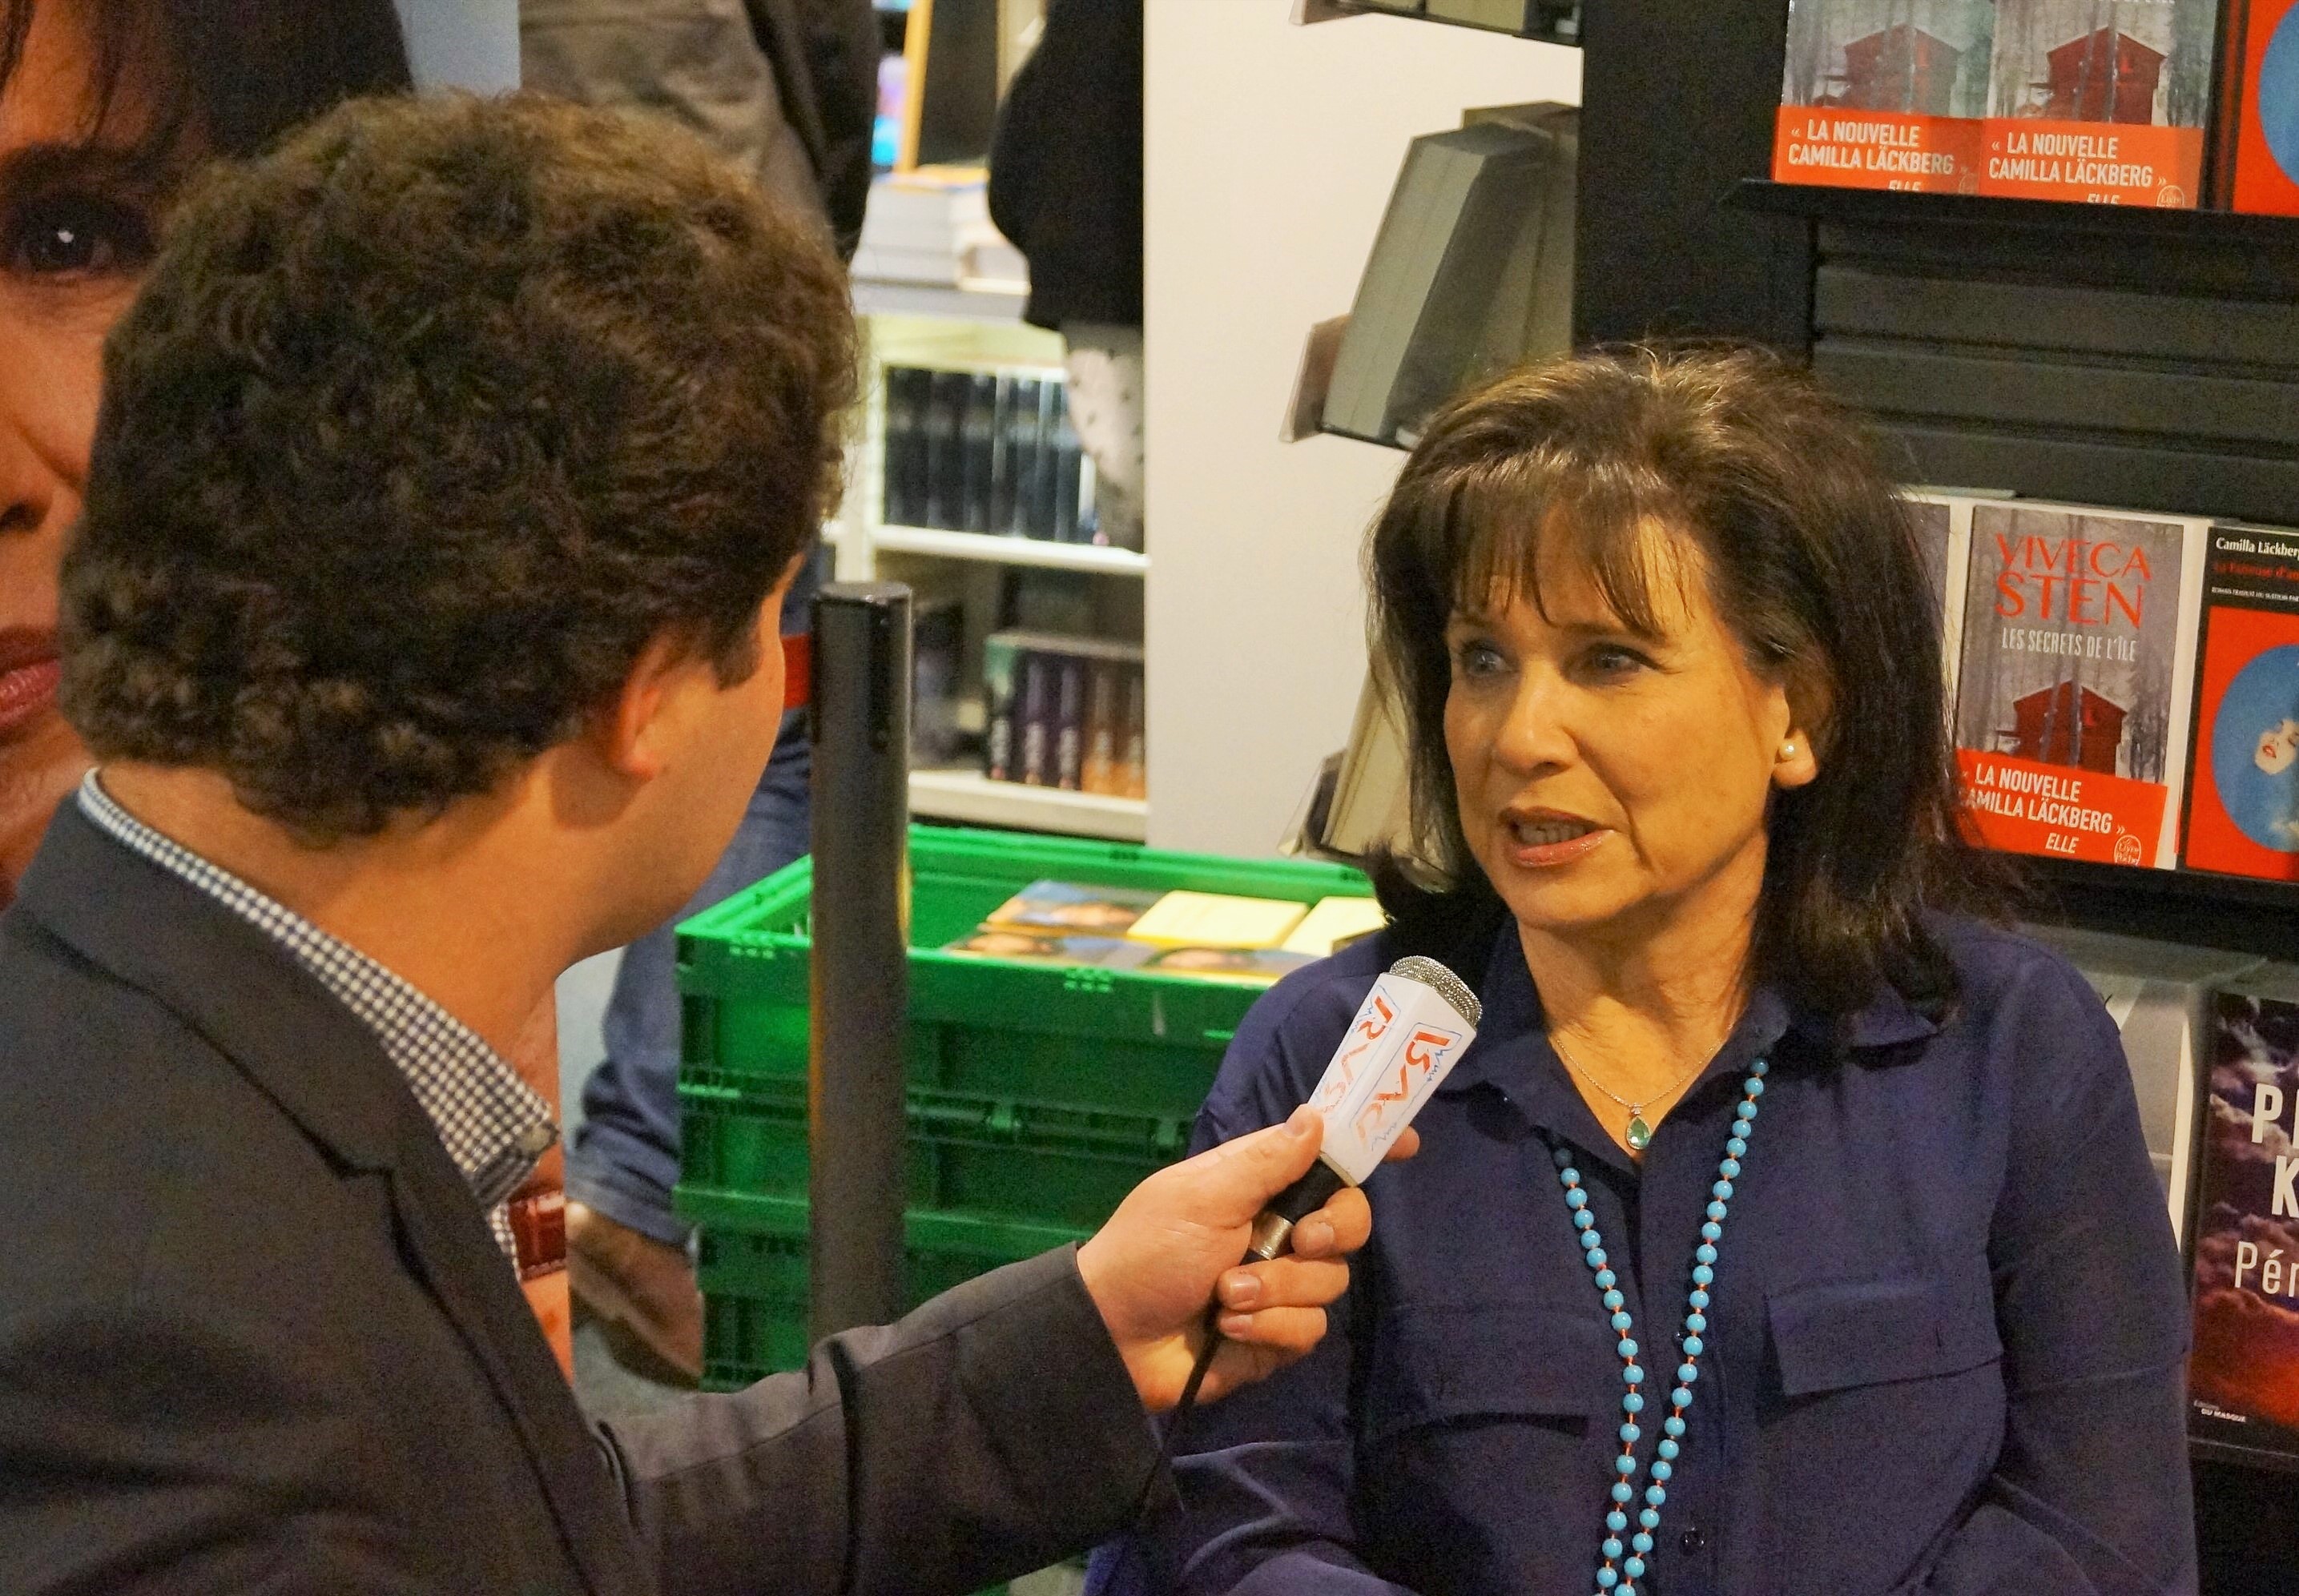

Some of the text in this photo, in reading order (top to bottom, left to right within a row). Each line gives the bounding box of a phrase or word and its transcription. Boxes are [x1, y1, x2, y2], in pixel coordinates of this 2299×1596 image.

[1807, 119, 1829, 141] LA
[1833, 121, 1921, 147] NOUVELLE
[2007, 132, 2027, 155] LA
[2032, 133, 2119, 159] NOUVELLE
[1788, 143, 1955, 175] CAMILLA LÄCKBERG
[1989, 158, 2060, 183] CAMILLA
[2065, 158, 2153, 187] LÄCKBERG
[1995, 533, 2152, 581] VIVECA
[2216, 537, 2299, 561] Camilla Läckber
[1995, 570, 2144, 629] STEN
[2002, 627, 2025, 651] LES
[2027, 629, 2082, 657] SECRETS
[2086, 635, 2102, 658] DE
[1975, 763, 1995, 786] LA
[1999, 768, 2083, 803] NOUVELLE
[1963, 788, 2024, 818] AMILLA
[2027, 797, 2113, 834] LÄCKBERG
[2045, 833, 2080, 854] ELLE
